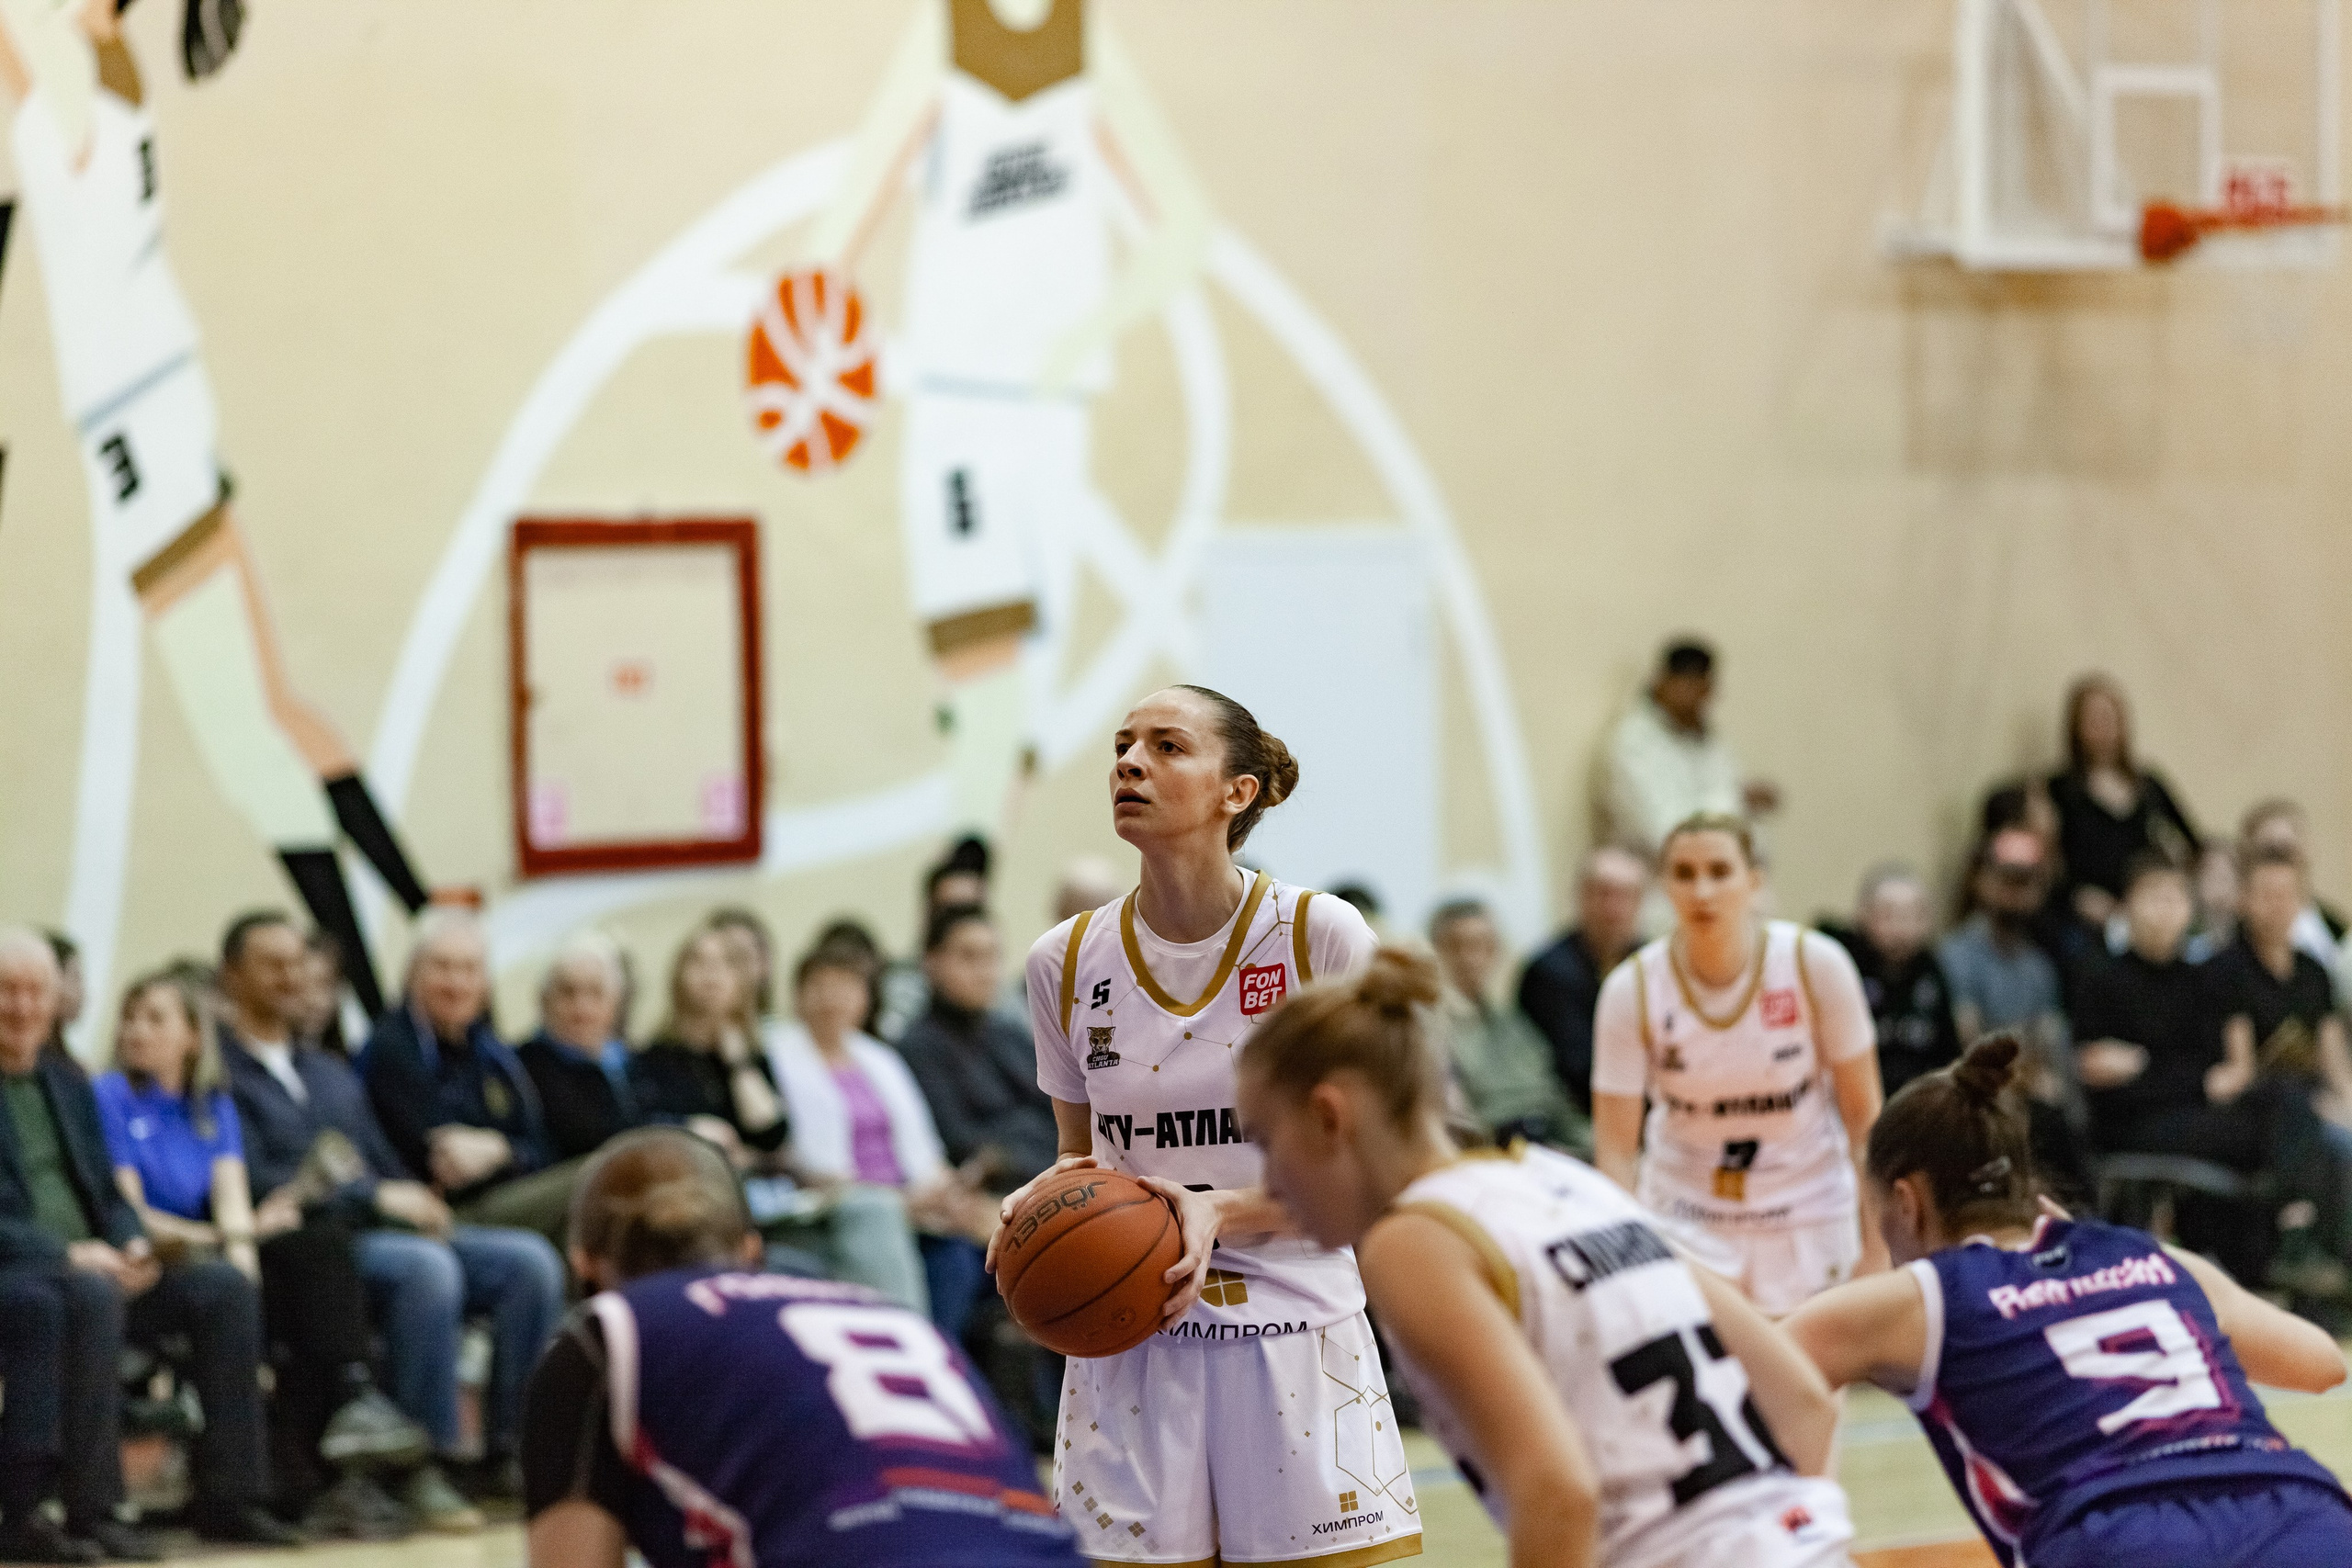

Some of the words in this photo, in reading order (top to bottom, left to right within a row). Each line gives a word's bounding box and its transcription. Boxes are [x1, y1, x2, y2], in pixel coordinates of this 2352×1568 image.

[1243, 968, 1282, 990] FON
[1243, 986, 1283, 1010] BET
[1087, 1058, 1119, 1070] ATLANTA
[1004, 1180, 1108, 1253] JÖGEL
[1157, 1320, 1308, 1340] ИМПРОМ
[779, 1302, 996, 1442] 8
[2042, 1298, 2223, 1435] 9
[1311, 1510, 1385, 1535] ХИМПРОМ
